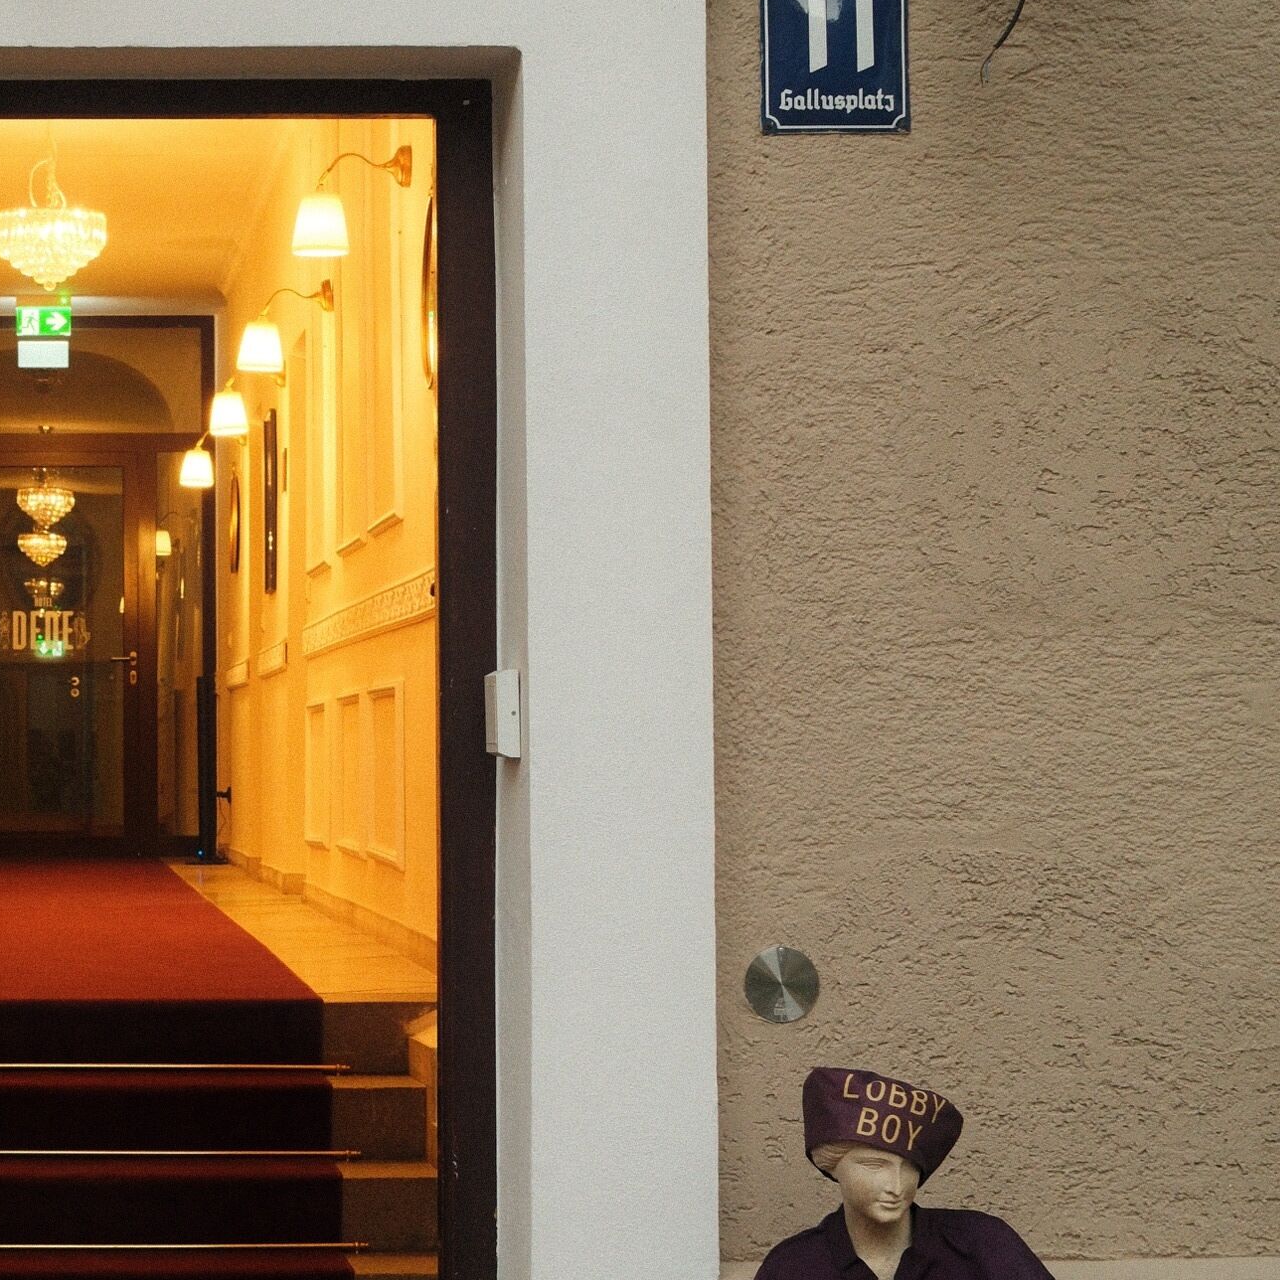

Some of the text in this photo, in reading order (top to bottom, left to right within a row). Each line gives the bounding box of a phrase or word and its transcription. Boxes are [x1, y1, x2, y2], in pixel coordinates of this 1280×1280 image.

[779, 88, 895, 113] Gallusplatz
[12, 610, 74, 650] DEDE
[842, 1073, 947, 1124] LOBBY
[856, 1107, 923, 1151] BOY
